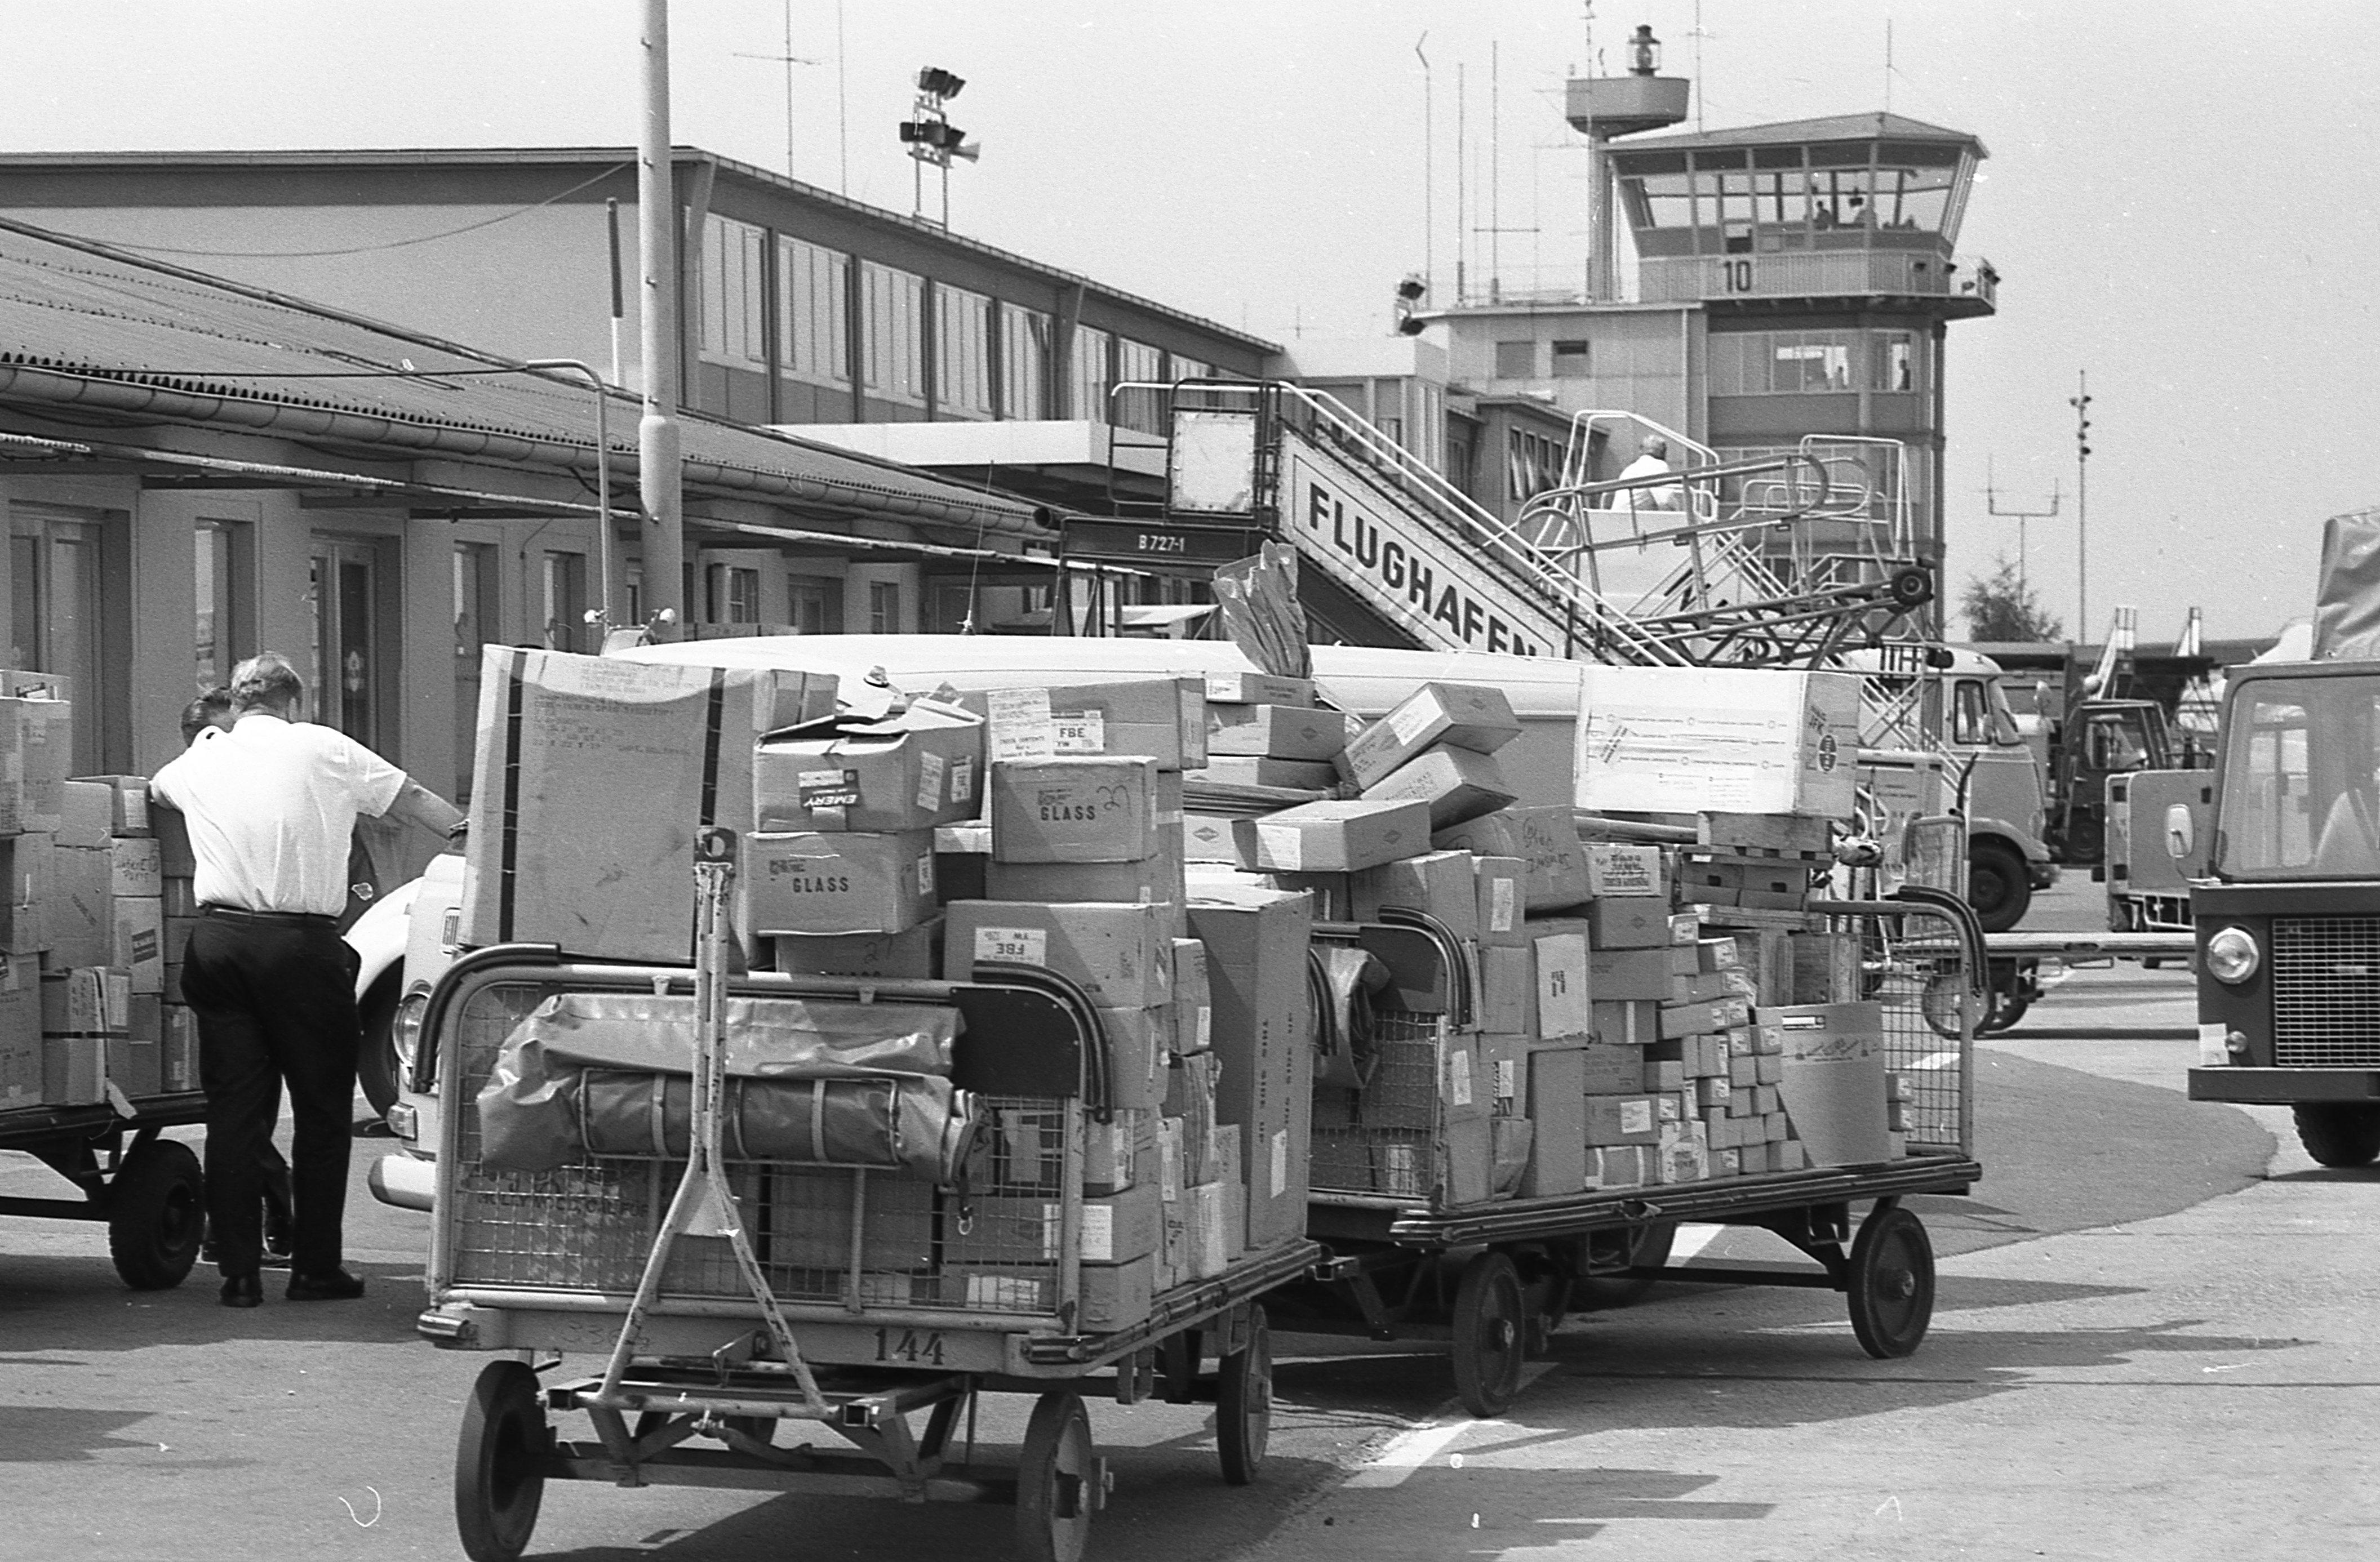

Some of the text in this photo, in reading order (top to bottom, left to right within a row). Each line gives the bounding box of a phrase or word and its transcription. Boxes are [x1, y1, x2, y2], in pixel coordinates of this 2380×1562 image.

[1724, 261, 1751, 293] 10
[1139, 535, 1184, 551] B 727-1
[1060, 727, 1085, 738] FBE
[803, 794, 857, 807] EMERY
[1041, 805, 1095, 821] GLASS
[793, 877, 849, 893] GLASS
[874, 1328, 945, 1365] 144
